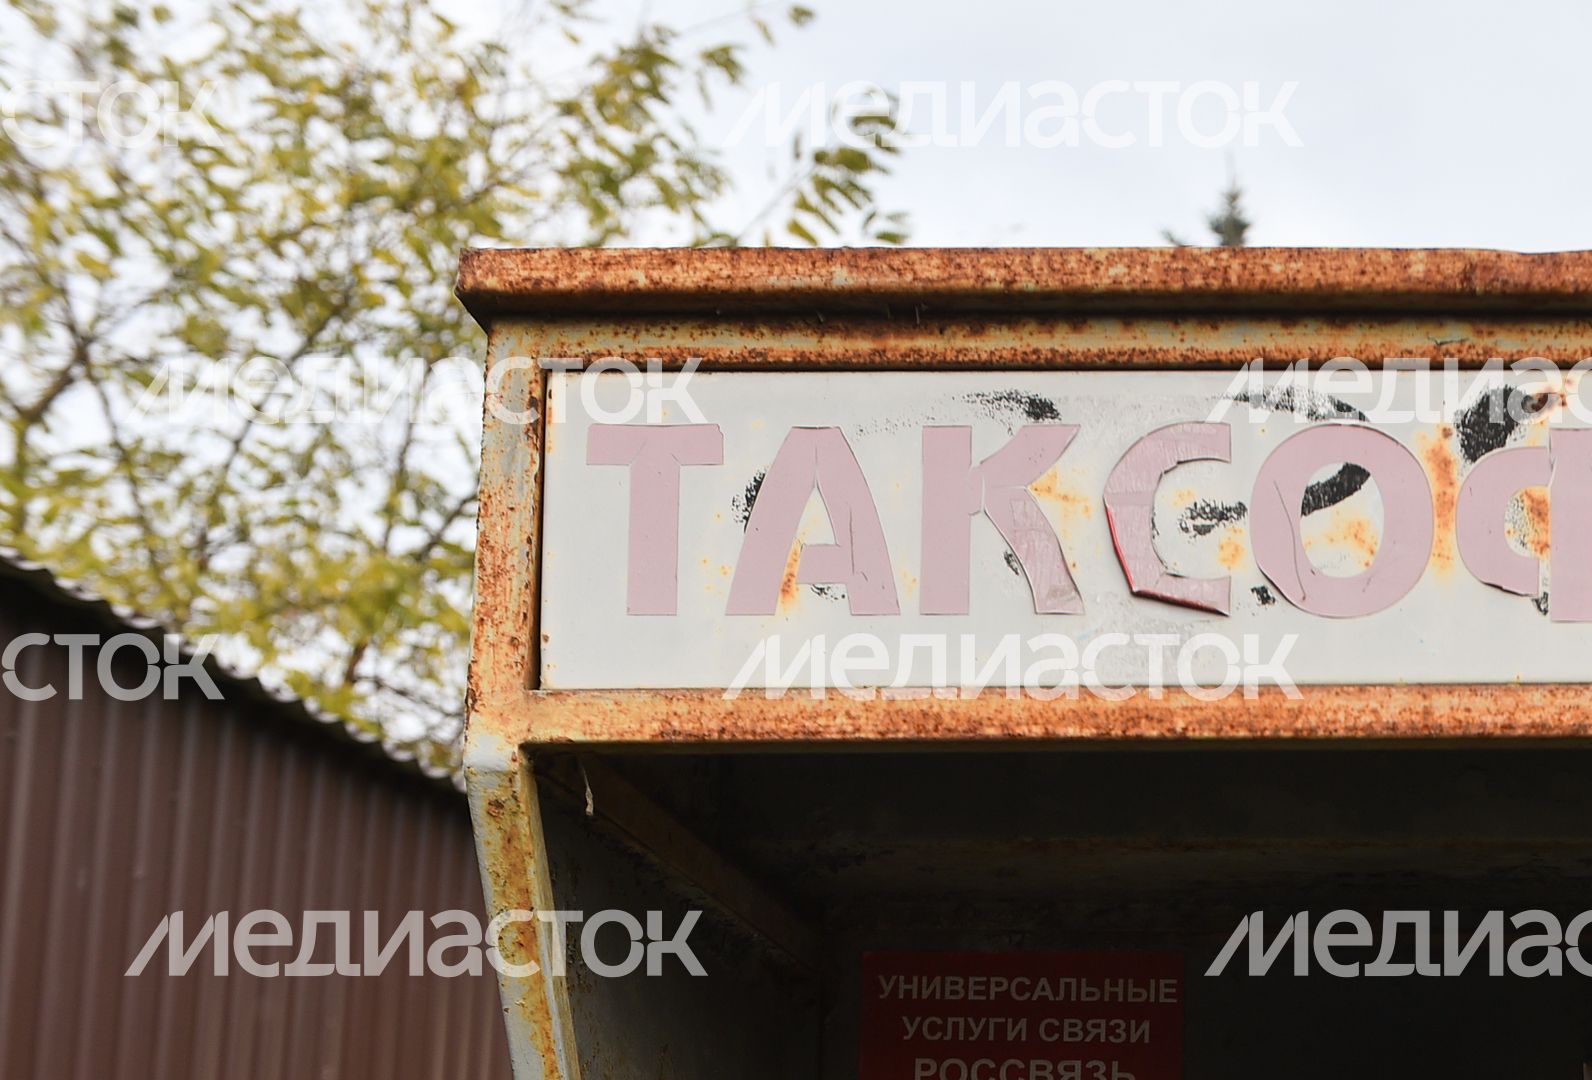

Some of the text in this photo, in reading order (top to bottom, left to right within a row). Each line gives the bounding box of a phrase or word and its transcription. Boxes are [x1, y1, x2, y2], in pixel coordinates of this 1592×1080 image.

[879, 975, 1178, 1003] УНИВЕРСАЛЬНЫЕ
[902, 1016, 1151, 1044] УСЛУГИ СВЯЗИ
